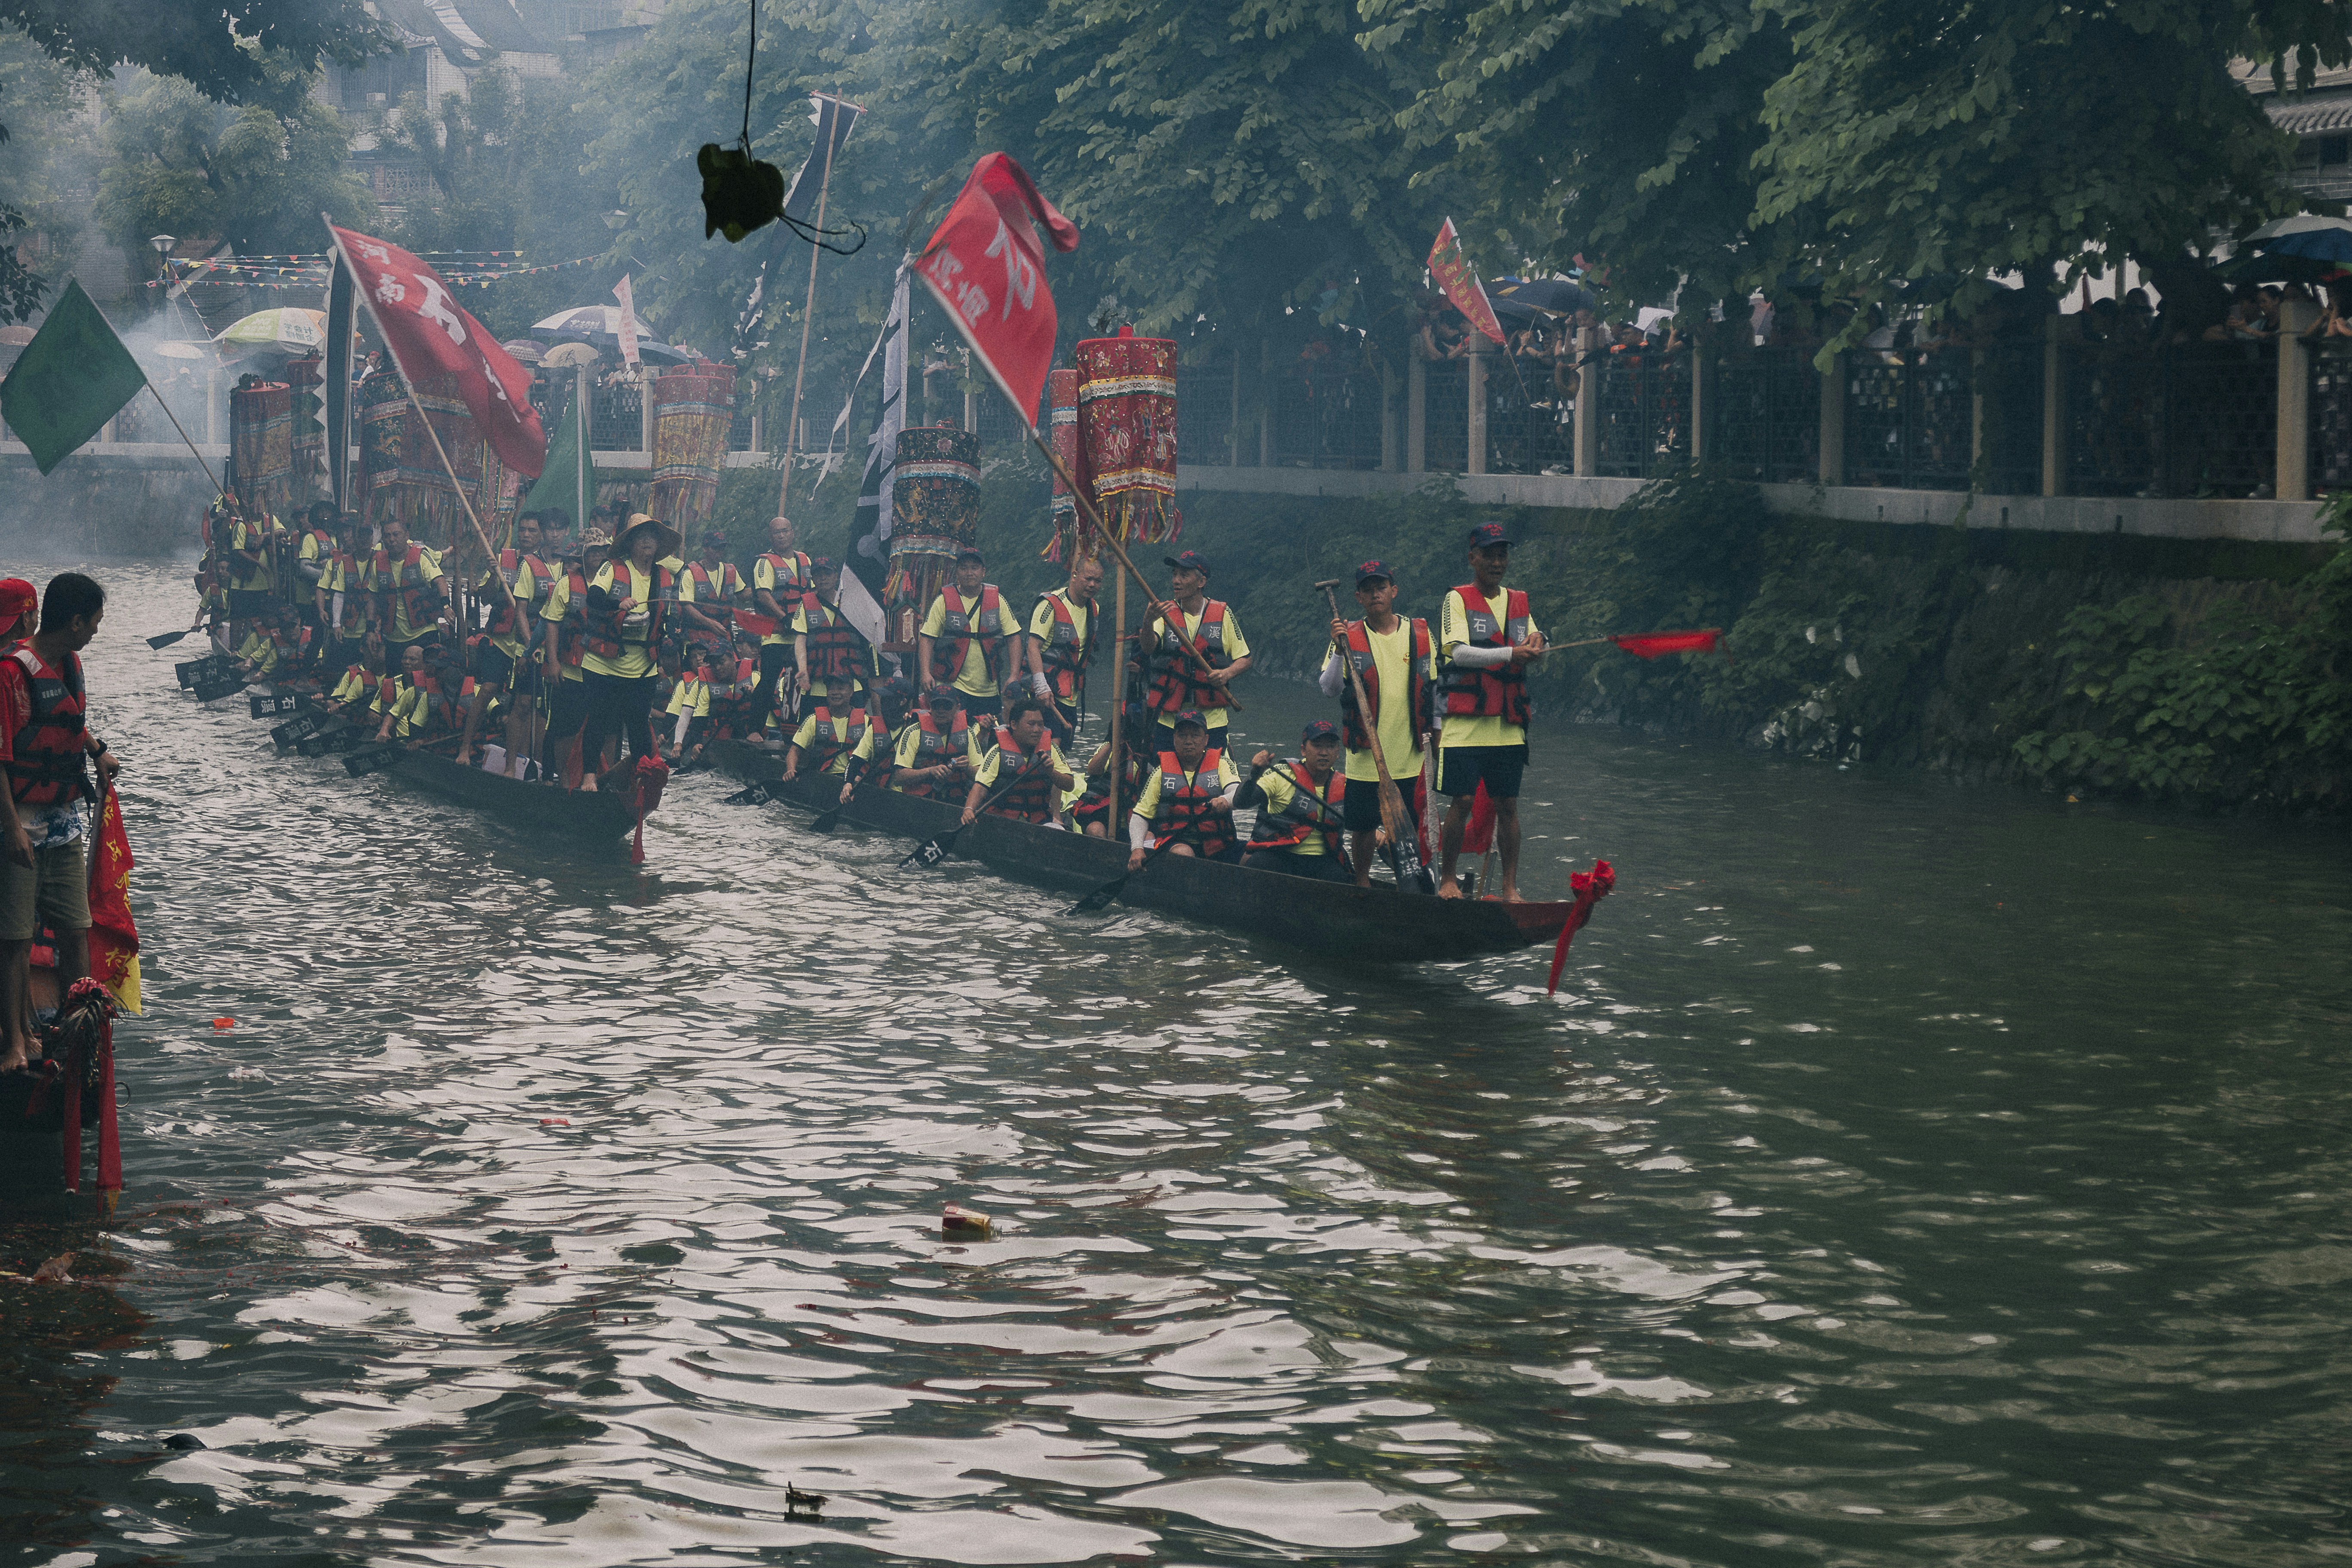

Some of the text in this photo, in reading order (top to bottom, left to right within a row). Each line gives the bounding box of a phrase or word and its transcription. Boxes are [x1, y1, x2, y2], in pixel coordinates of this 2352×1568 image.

[355, 239, 405, 305] 河南
[284, 322, 313, 334] 学会计
[286, 330, 315, 343] 到恒企
[502, 572, 511, 582] 石
[777, 570, 786, 579] 石
[380, 576, 387, 584] 石
[539, 580, 548, 590] 石
[613, 584, 622, 594] 石
[698, 585, 706, 593] 石
[572, 597, 581, 606] 石
[809, 615, 818, 624] 石
[951, 615, 998, 626] 石 溪
[1473, 618, 1487, 633] 石
[1060, 627, 1070, 637] 石
[1168, 626, 1221, 642] 石 溪
[712, 686, 720, 695] 石
[260, 695, 296, 714] 石溪
[285, 717, 315, 741] 石溪
[819, 725, 862, 738] 石 溪
[875, 737, 883, 747] 石
[925, 736, 934, 746] 石
[1004, 755, 1016, 766] 石
[1164, 775, 1219, 790] 石 溪
[1298, 796, 1311, 809] 石
